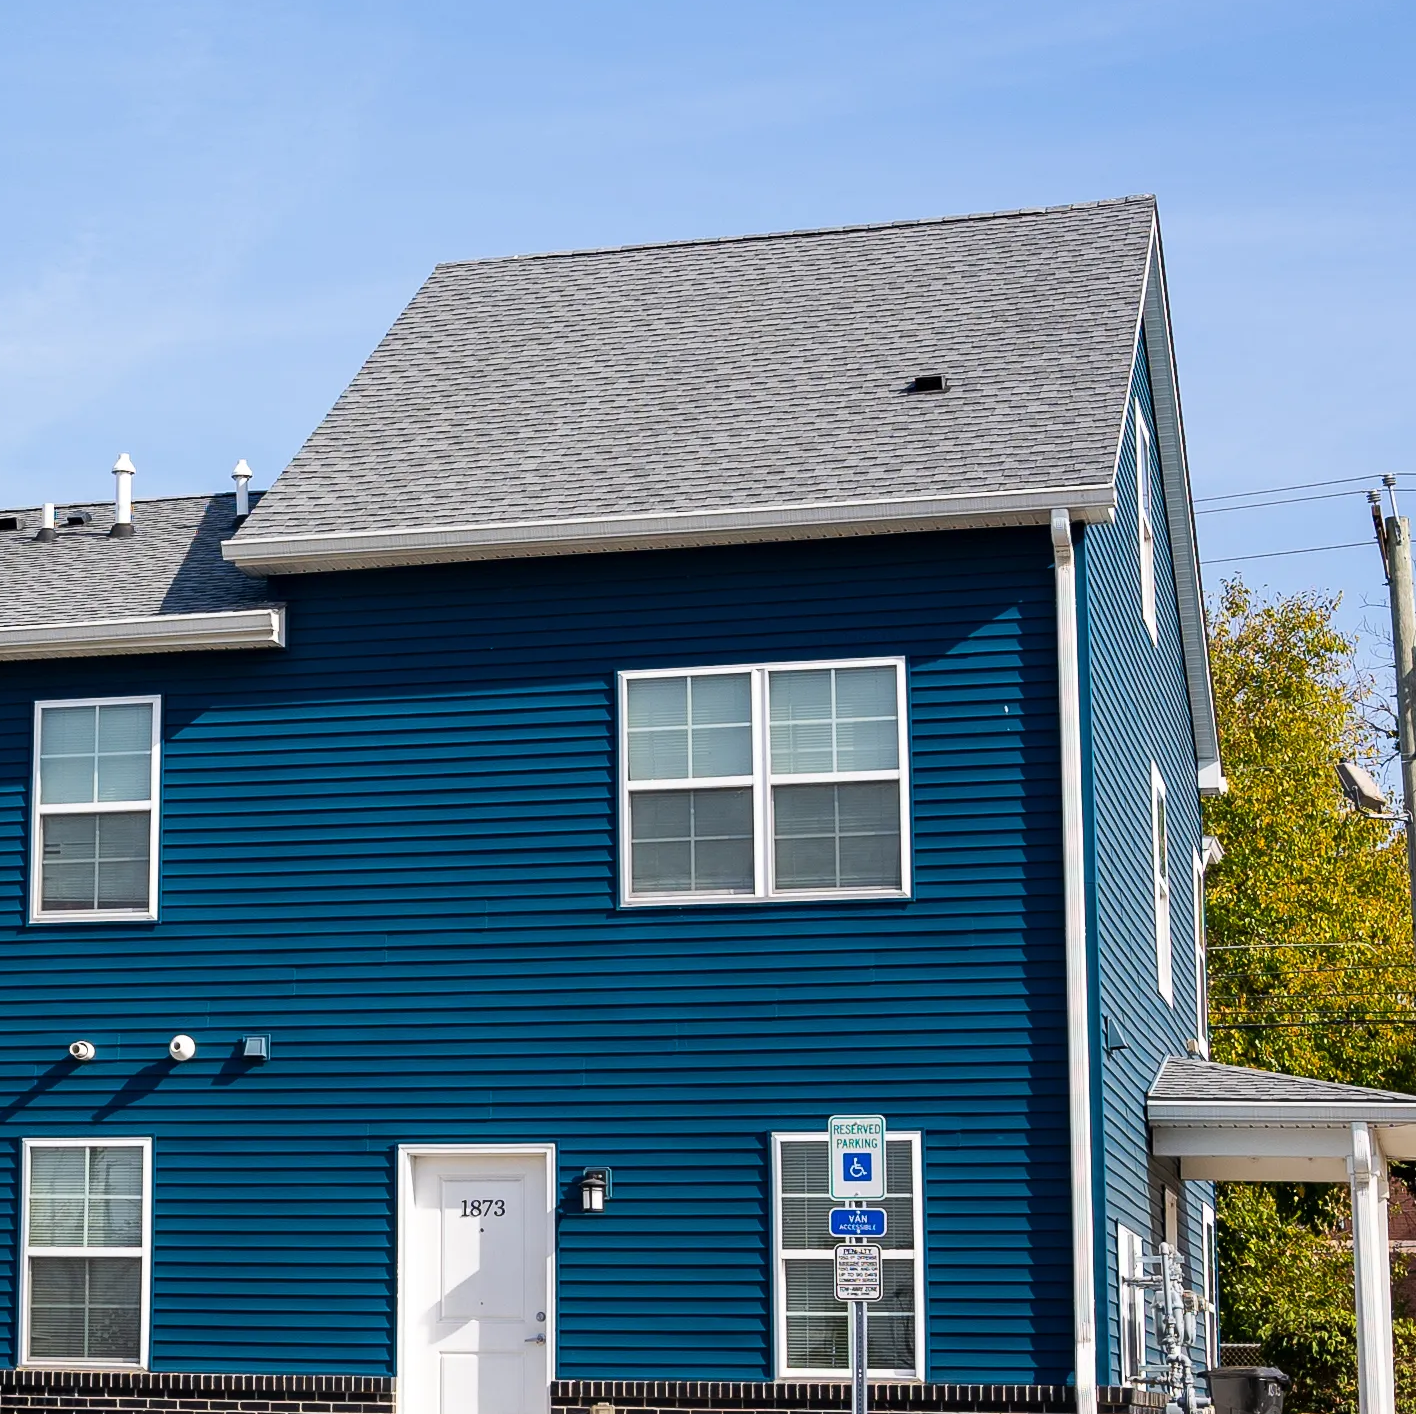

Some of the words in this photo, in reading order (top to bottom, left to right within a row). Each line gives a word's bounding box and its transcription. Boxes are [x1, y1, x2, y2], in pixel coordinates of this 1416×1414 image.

[833, 1123, 880, 1135] RESERVED
[836, 1138, 878, 1149] PARKING
[461, 1199, 506, 1217] 1873
[848, 1214, 868, 1223] VAN
